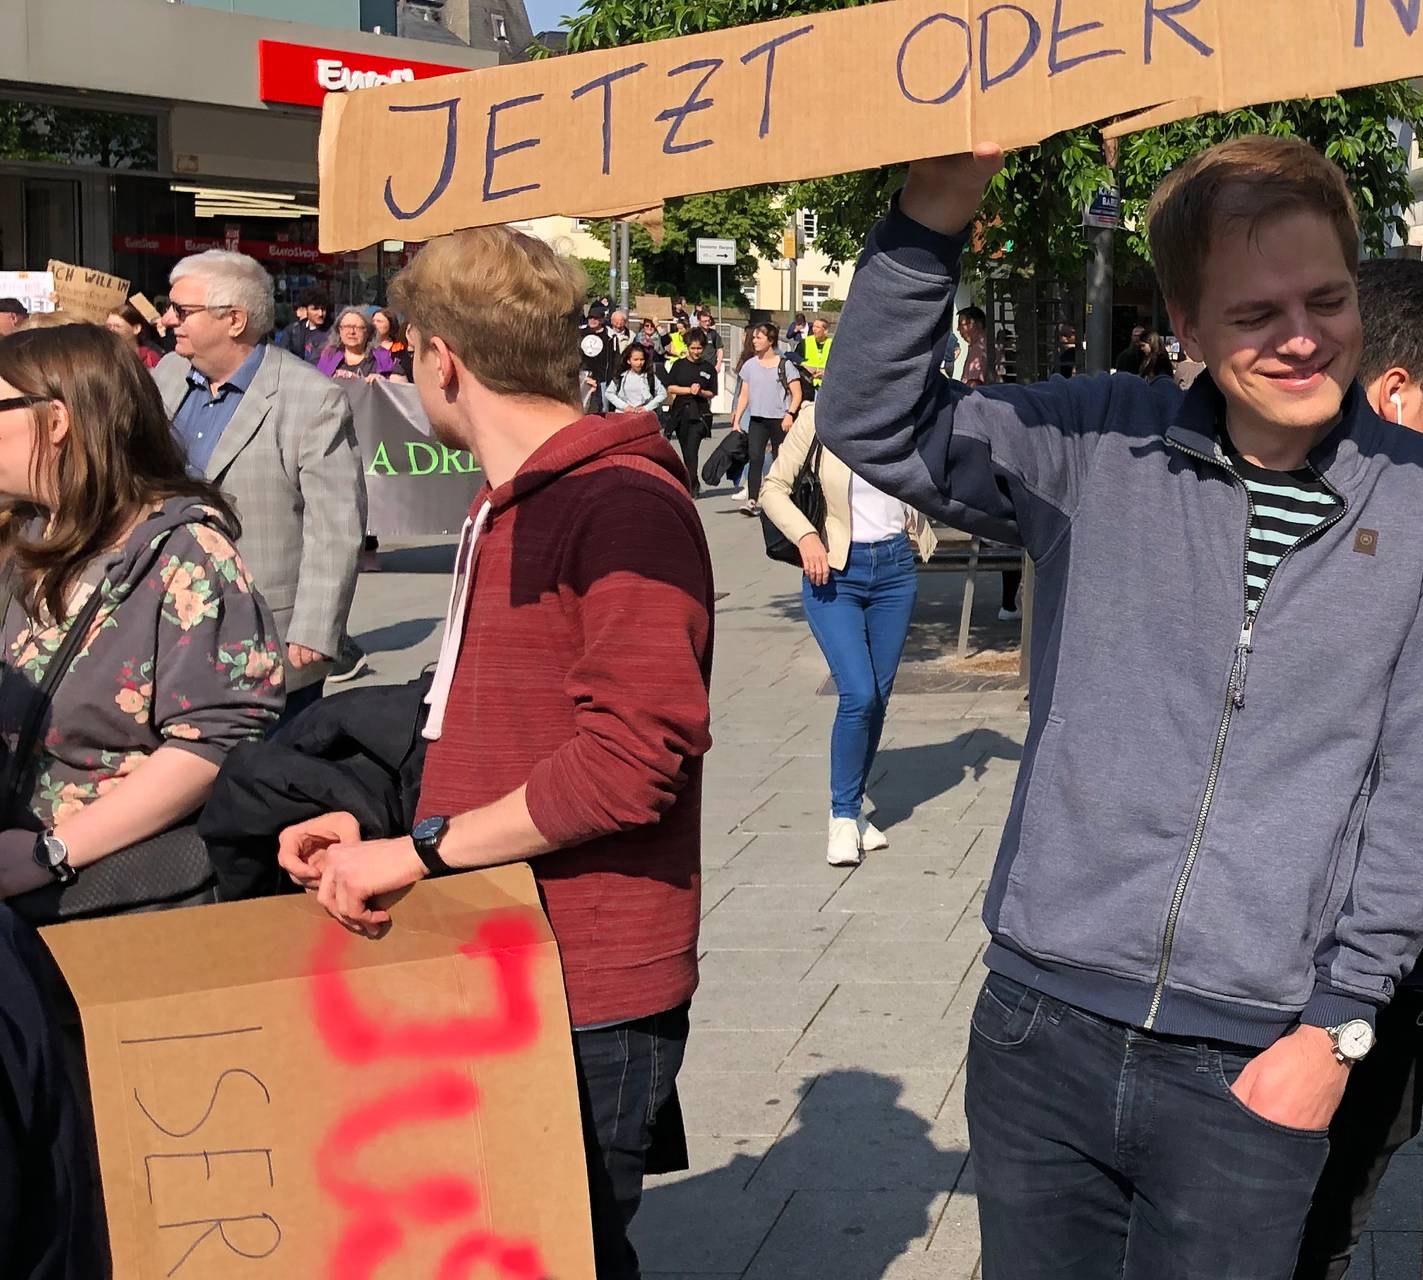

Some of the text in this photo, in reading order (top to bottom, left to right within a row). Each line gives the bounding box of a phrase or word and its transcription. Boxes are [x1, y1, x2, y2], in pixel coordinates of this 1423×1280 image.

[384, 0, 1214, 220] JETZT ODER
[366, 441, 398, 475] A
